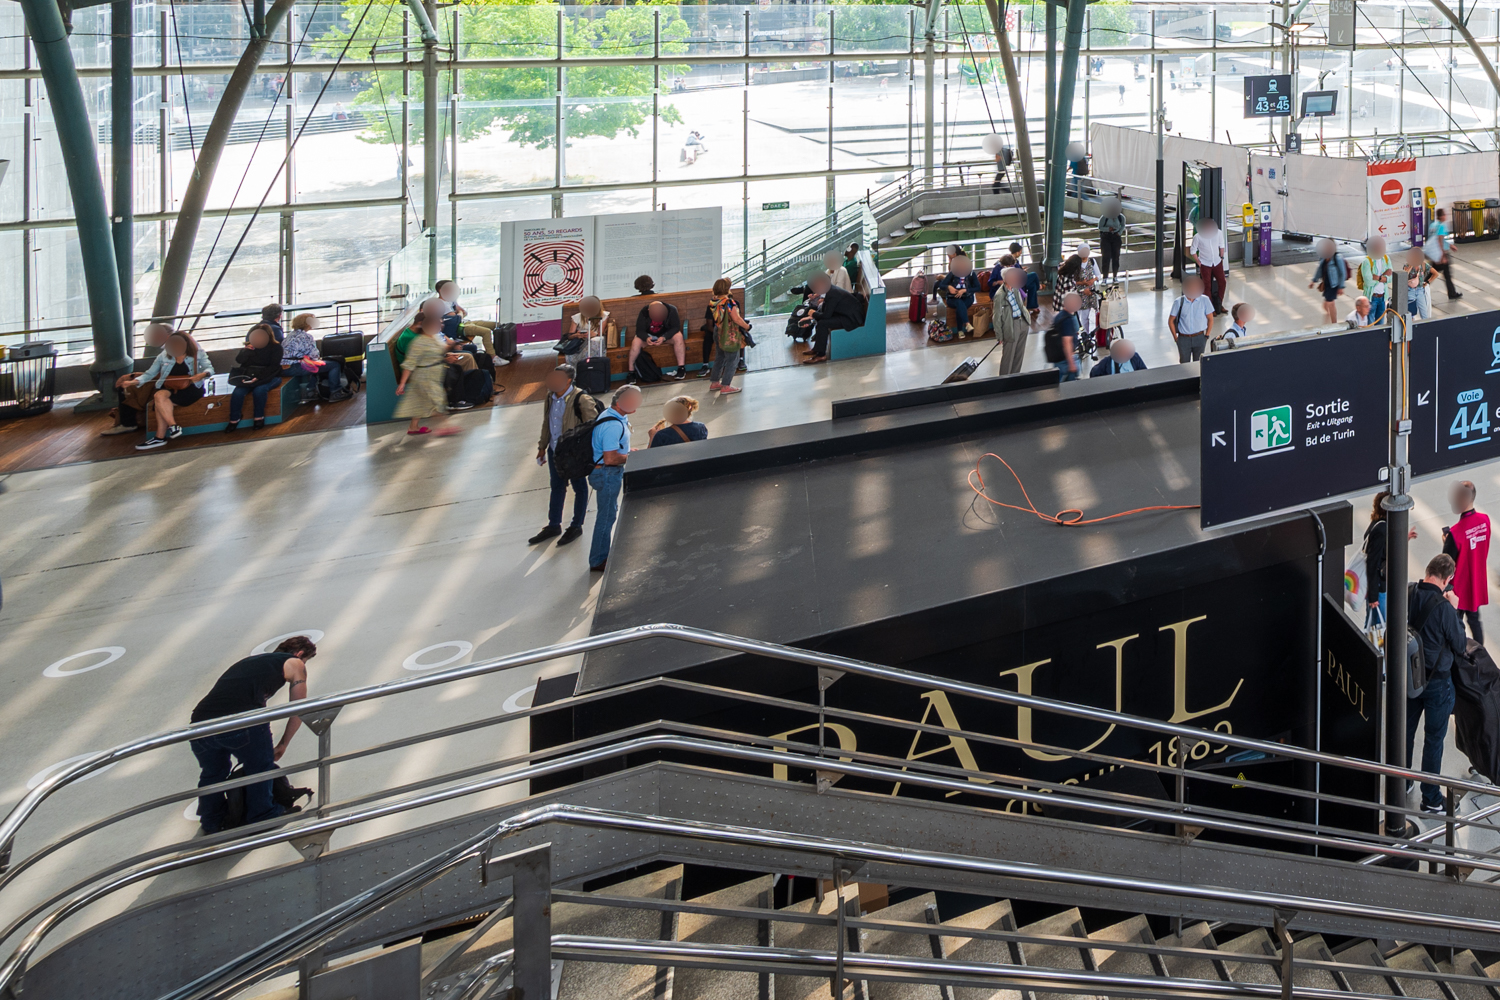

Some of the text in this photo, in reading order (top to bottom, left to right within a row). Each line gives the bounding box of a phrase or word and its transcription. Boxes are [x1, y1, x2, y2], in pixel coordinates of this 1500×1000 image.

[1256, 101, 1269, 112] 43
[1276, 100, 1290, 111] 45
[1461, 392, 1480, 402] Voie
[1306, 398, 1350, 419] Sortie
[1306, 415, 1353, 430] Exit Uitgang
[1450, 402, 1491, 440] 44
[1305, 428, 1355, 447] Bd de Turin
[1327, 649, 1369, 722] PAUL
[751, 615, 1244, 798] PAUL
